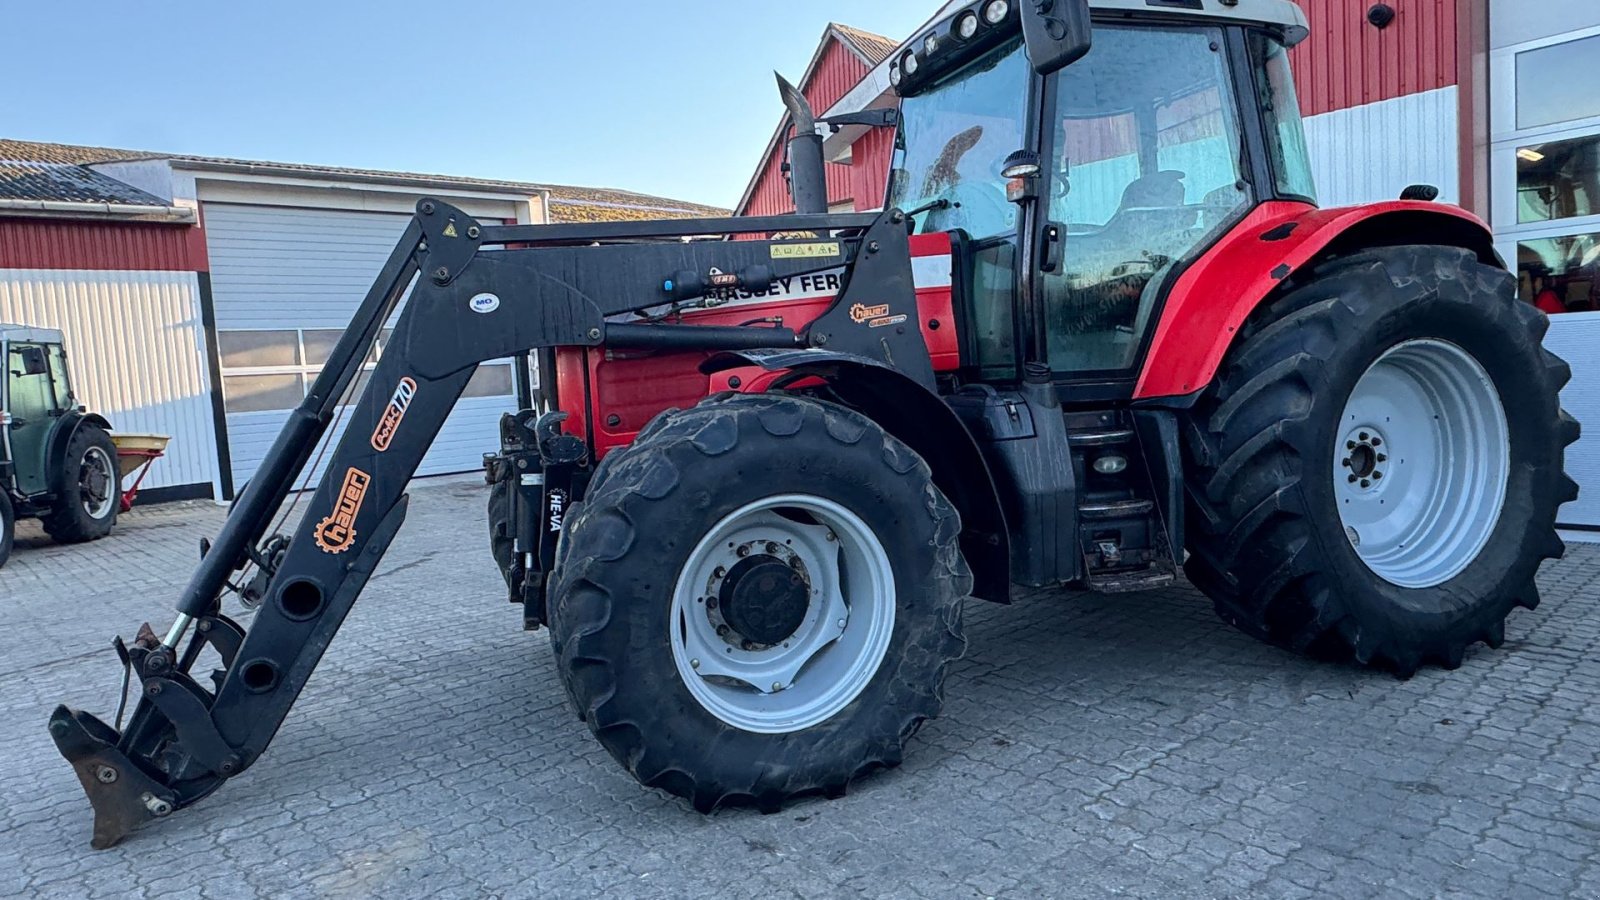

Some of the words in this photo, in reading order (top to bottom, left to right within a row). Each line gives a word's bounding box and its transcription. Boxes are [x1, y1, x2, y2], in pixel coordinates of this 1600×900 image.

[800, 273, 844, 292] FER
[855, 305, 887, 319] hauer
[324, 472, 367, 543] hauer
[550, 494, 562, 531] HE-VA
